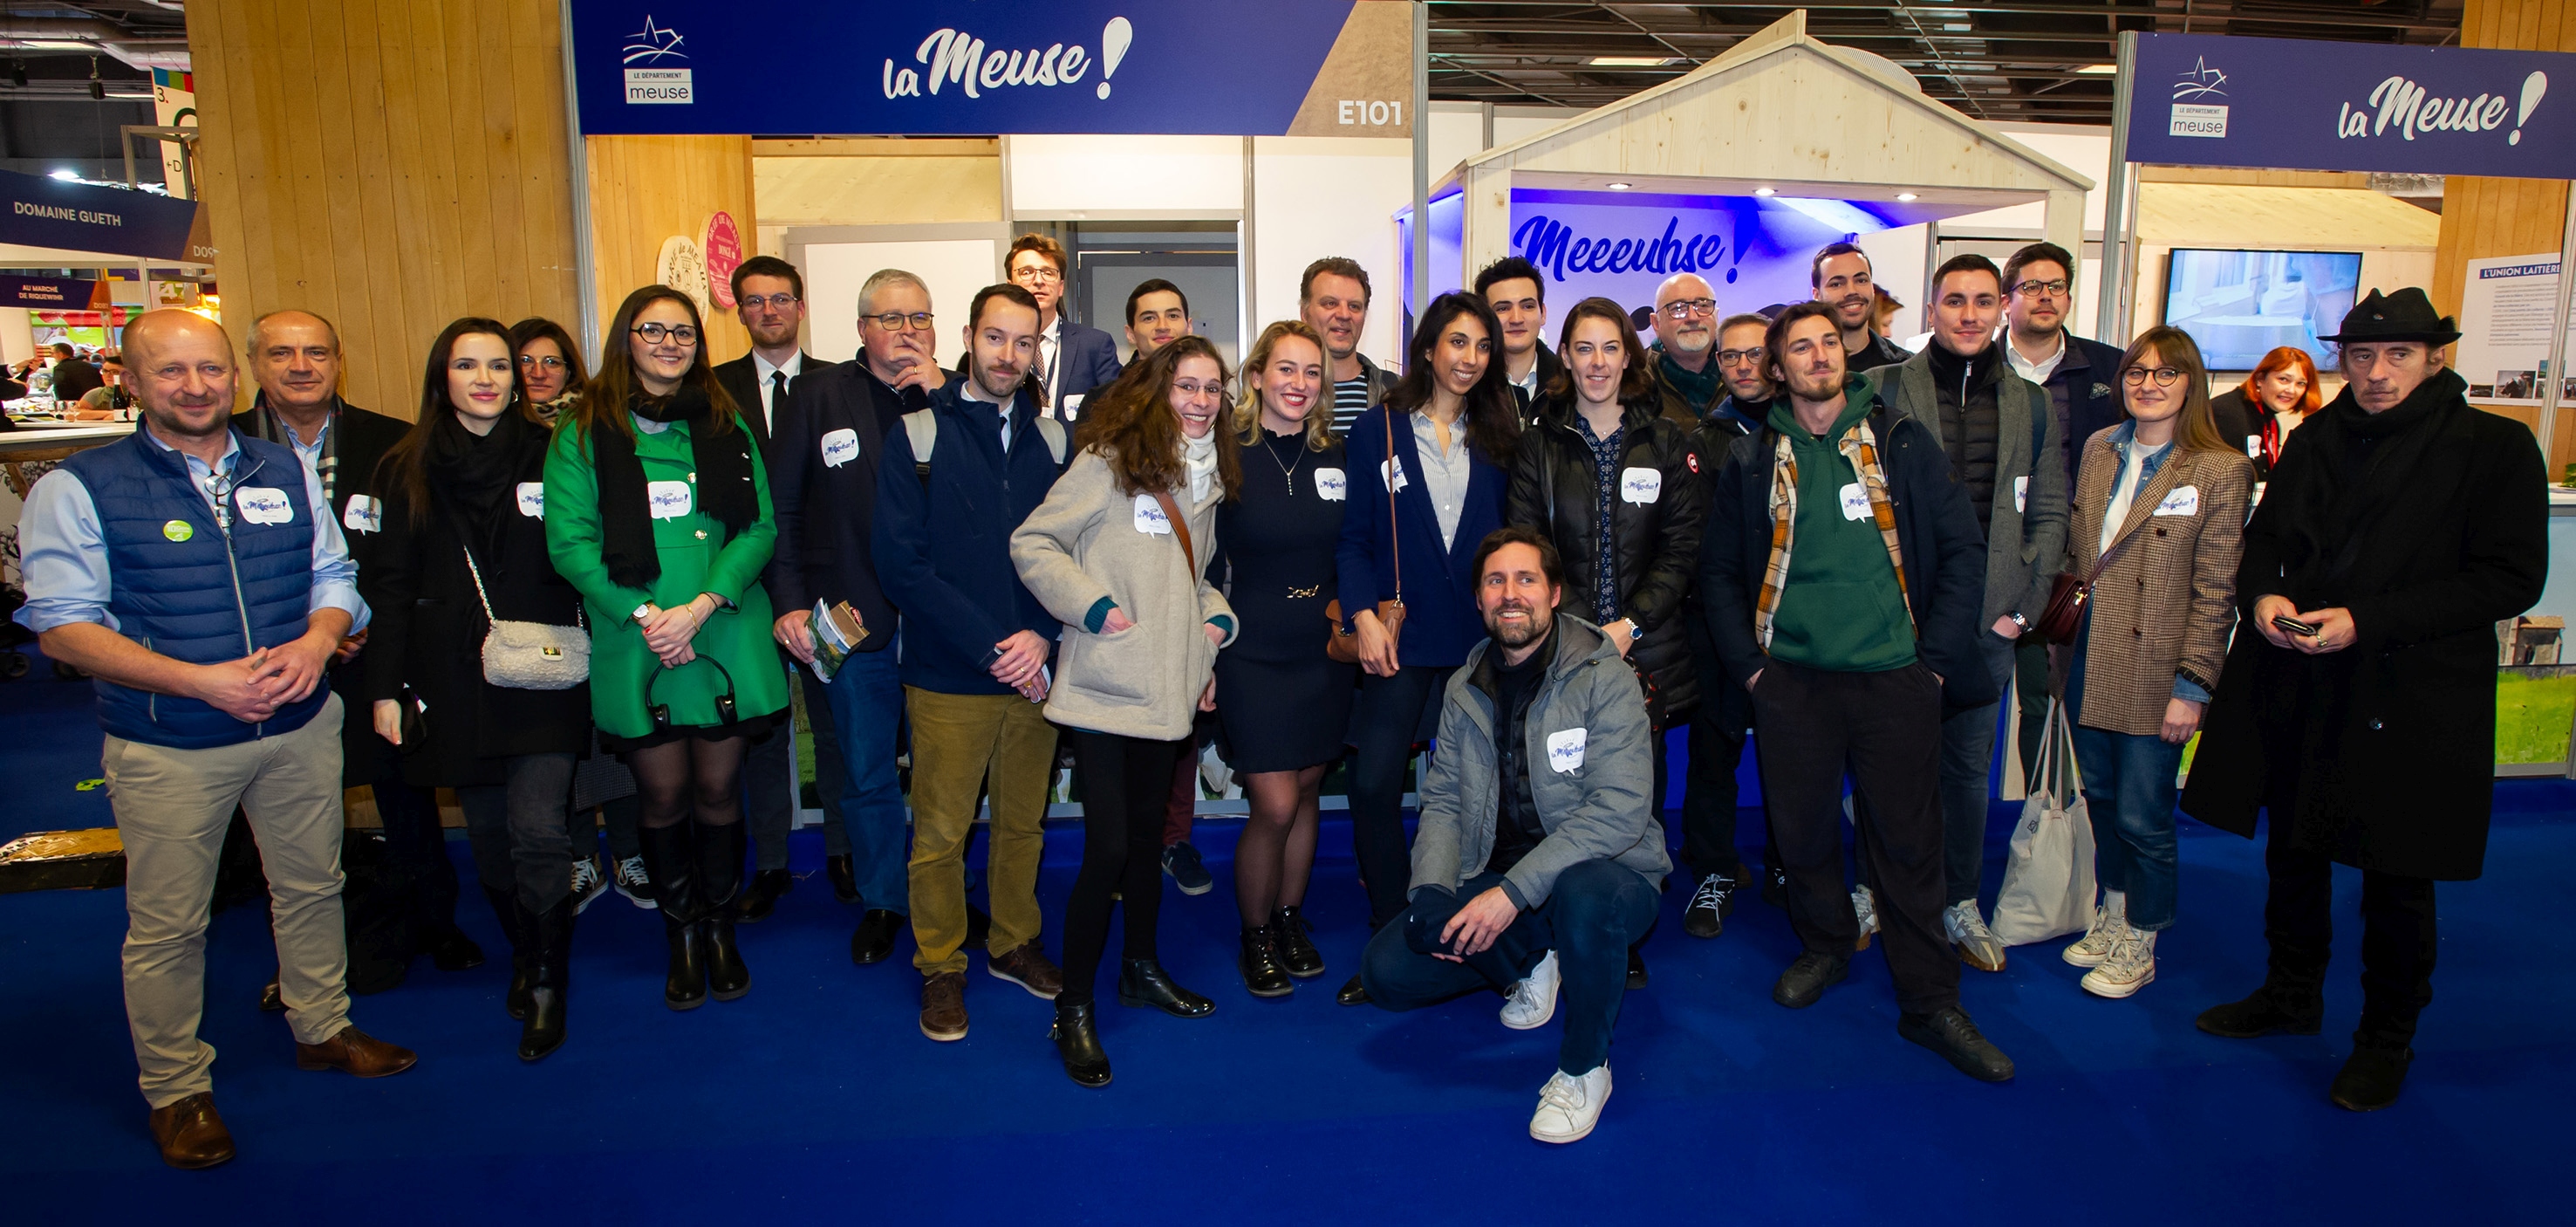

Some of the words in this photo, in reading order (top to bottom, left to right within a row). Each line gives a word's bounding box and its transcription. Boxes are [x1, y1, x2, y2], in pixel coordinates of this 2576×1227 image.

[883, 58, 921, 99] la
[630, 87, 689, 99] meuse
[1338, 99, 1402, 126] E101
[2338, 101, 2368, 140] la
[2173, 120, 2224, 134] meuse
[14, 201, 77, 222] DOMAINE
[79, 209, 122, 227] GUETH
[193, 244, 218, 259] D09
[2484, 267, 2522, 278] L'UNION
